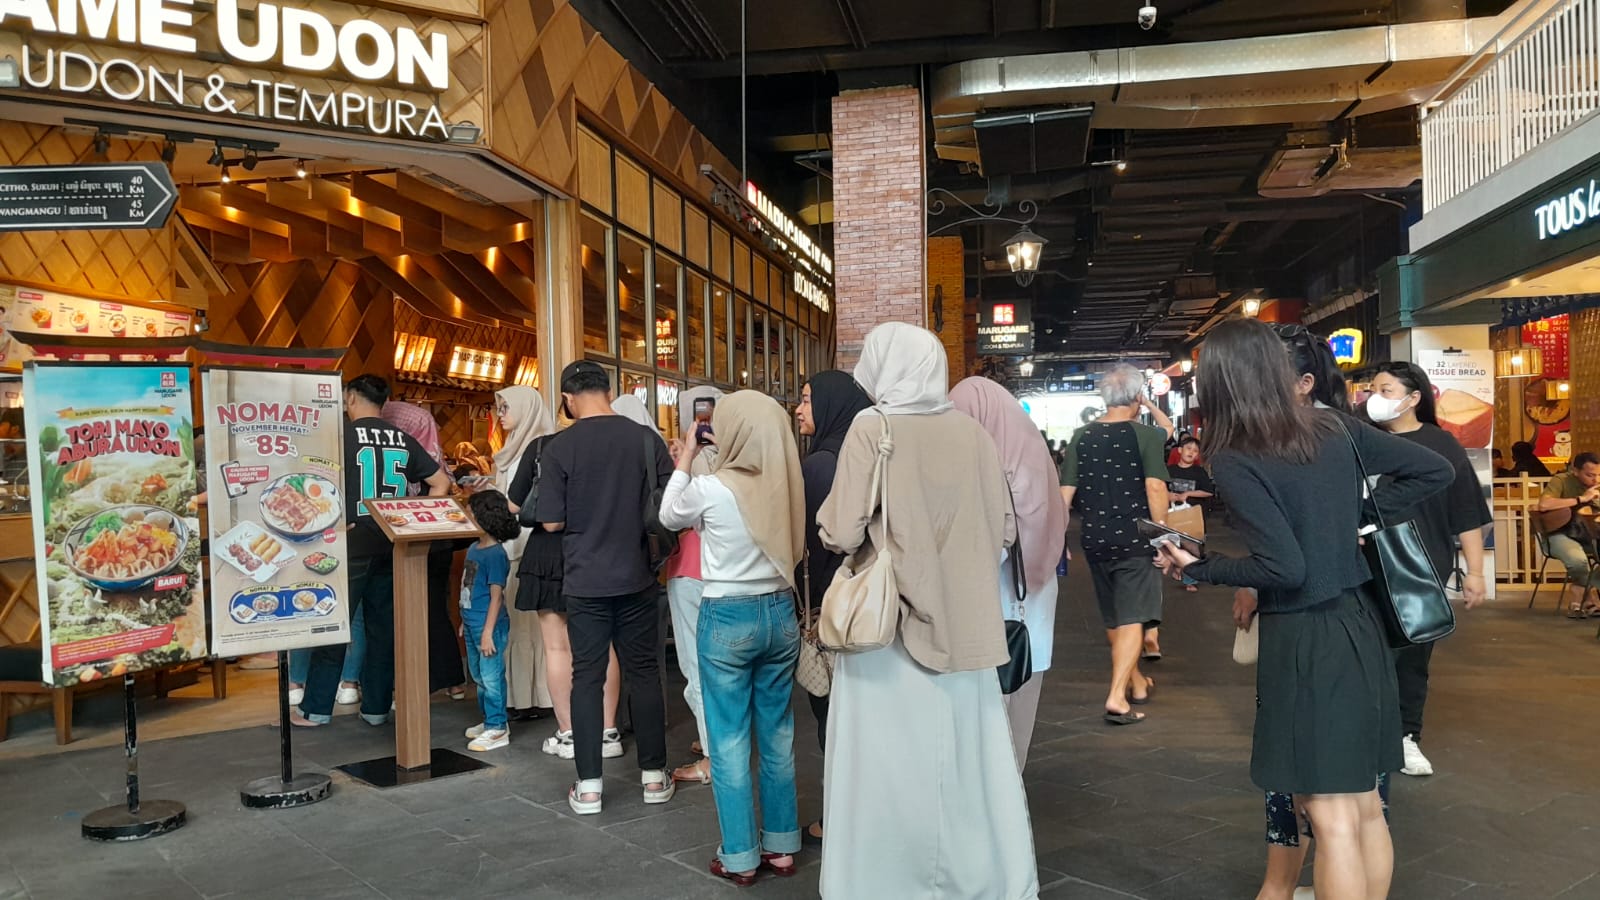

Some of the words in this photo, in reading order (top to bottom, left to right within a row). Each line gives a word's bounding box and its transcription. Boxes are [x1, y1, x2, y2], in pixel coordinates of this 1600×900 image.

[217, 0, 448, 89] UDON
[22, 45, 183, 104] UDON
[204, 74, 237, 114] &
[251, 79, 449, 138] TEMPURA
[131, 176, 142, 184] 40
[131, 200, 142, 208] 45
[1535, 187, 1586, 240] TOUS
[978, 325, 1029, 334] MARUGAME
[991, 334, 1016, 342] UDON
[217, 402, 320, 427] NOMAT!
[66, 421, 111, 442] TORI
[115, 419, 169, 439] MAYO
[232, 424, 277, 434] NOVEMBER
[257, 434, 290, 455] 85
[57, 439, 125, 465] ABURA
[126, 437, 180, 457] UDON
[309, 458, 330, 466] NOMAT
[377, 500, 452, 510] MASUK
[158, 576, 183, 587] BARU!
